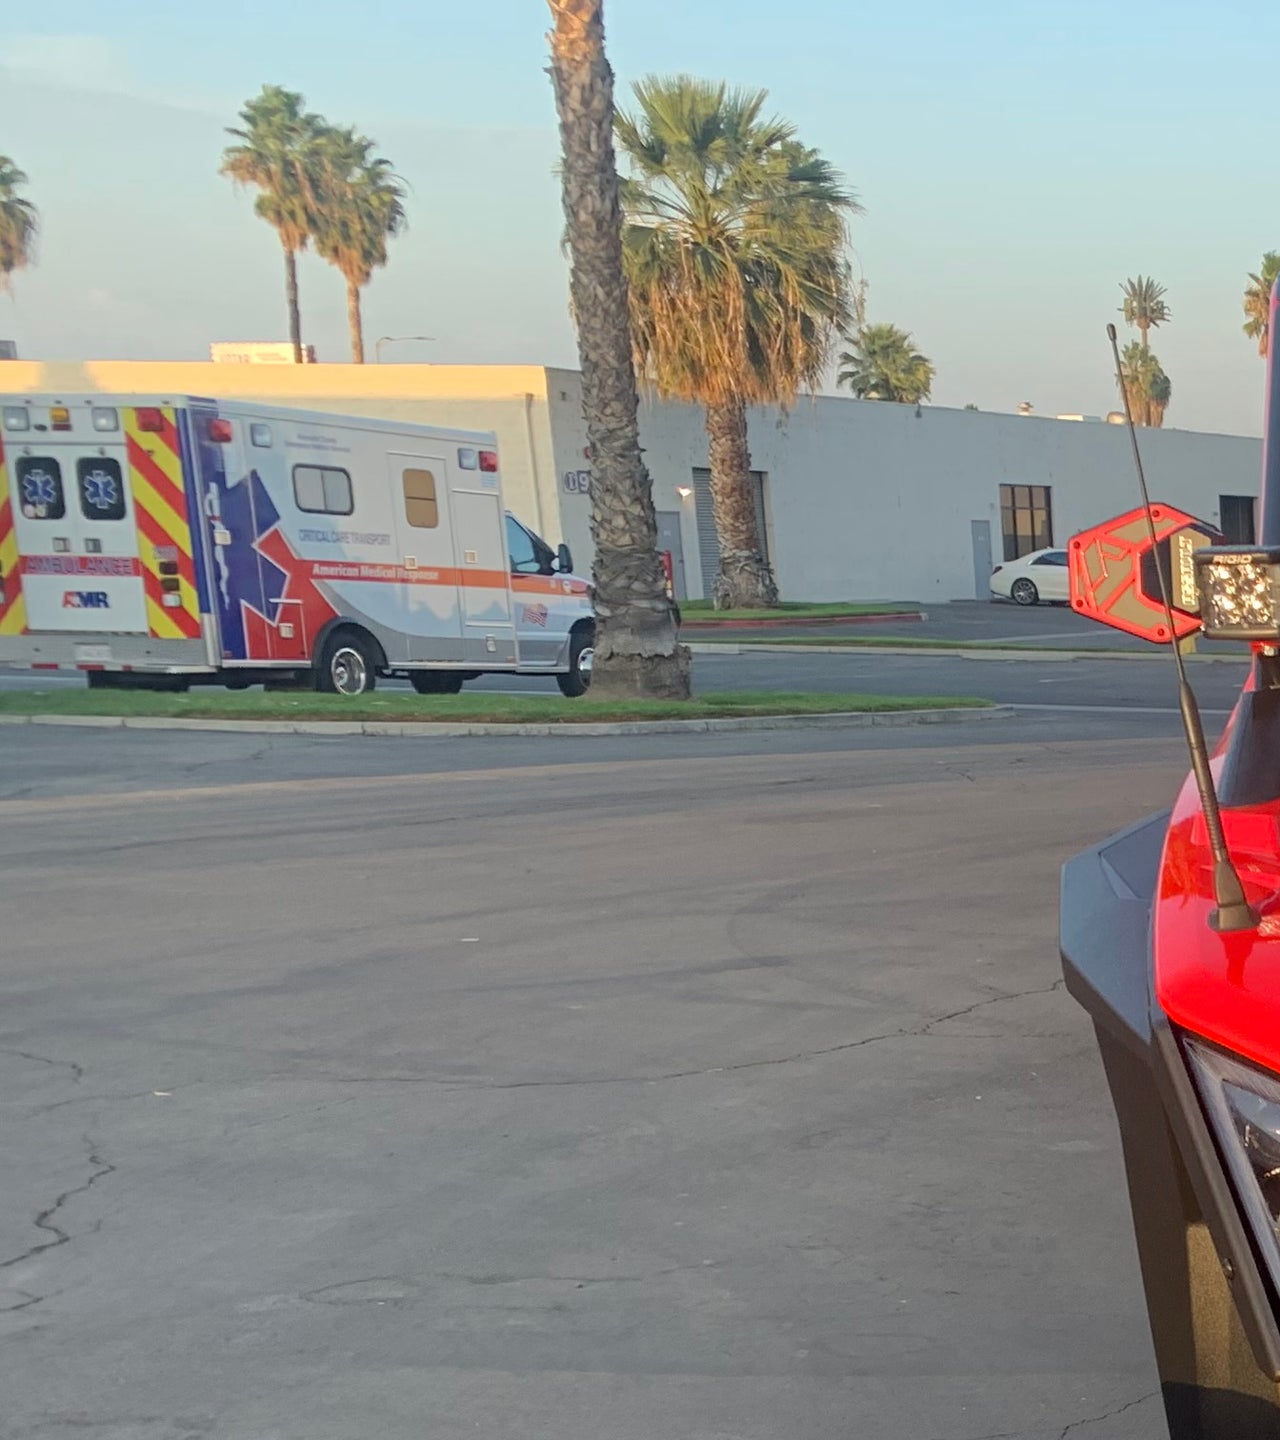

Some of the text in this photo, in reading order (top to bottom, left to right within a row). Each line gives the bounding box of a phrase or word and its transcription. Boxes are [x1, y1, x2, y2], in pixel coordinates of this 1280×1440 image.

[27, 556, 132, 576] AMBULANCE
[1213, 554, 1252, 565] RIGID
[312, 563, 440, 582] American Medical Response
[62, 591, 110, 608] AMR
